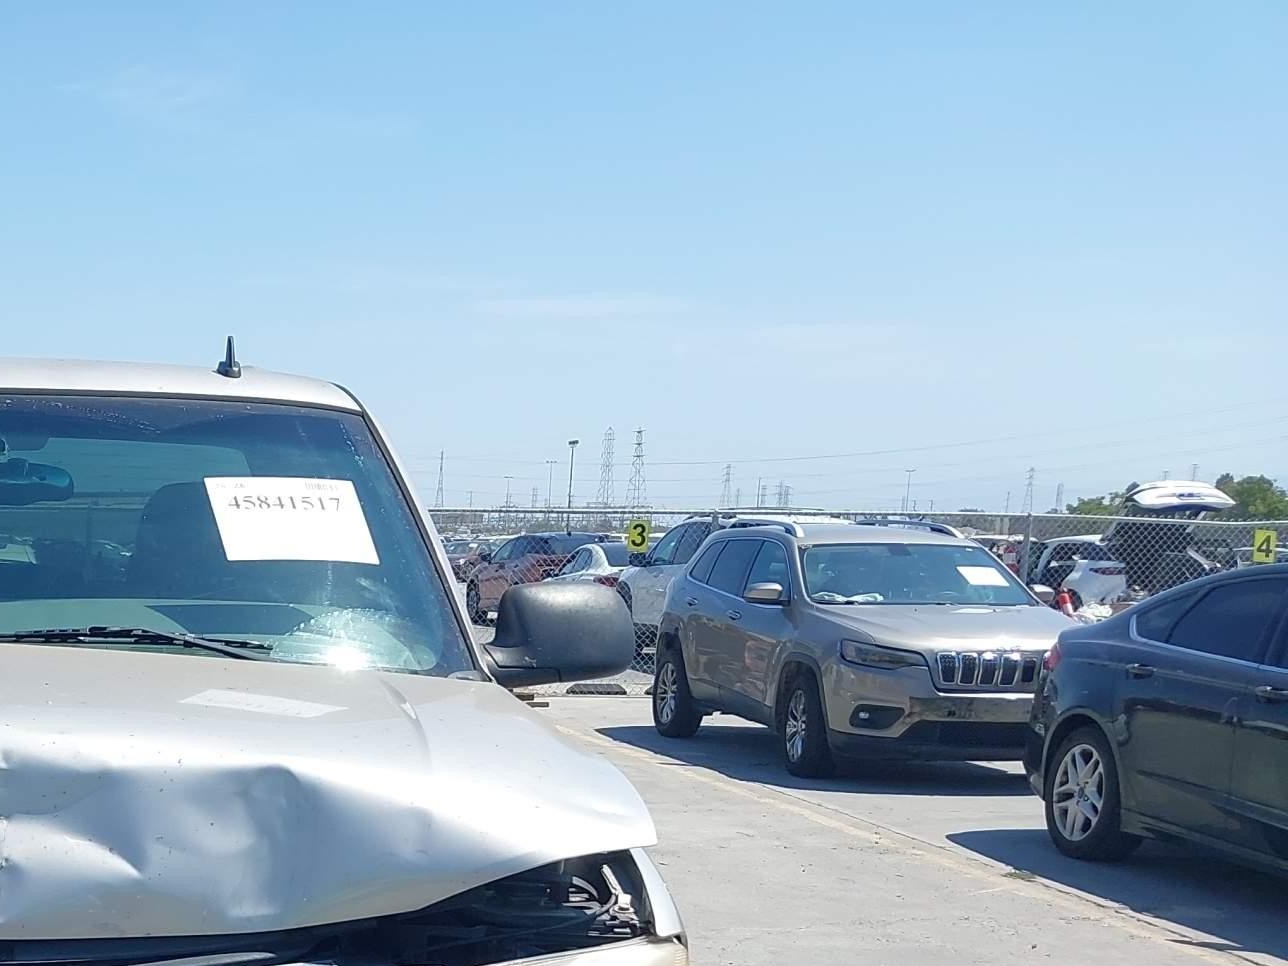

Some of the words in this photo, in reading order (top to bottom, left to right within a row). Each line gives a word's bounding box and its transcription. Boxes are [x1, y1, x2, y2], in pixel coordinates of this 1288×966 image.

[228, 495, 341, 512] 45841517
[631, 523, 646, 547] 3
[1256, 534, 1273, 559] 4
